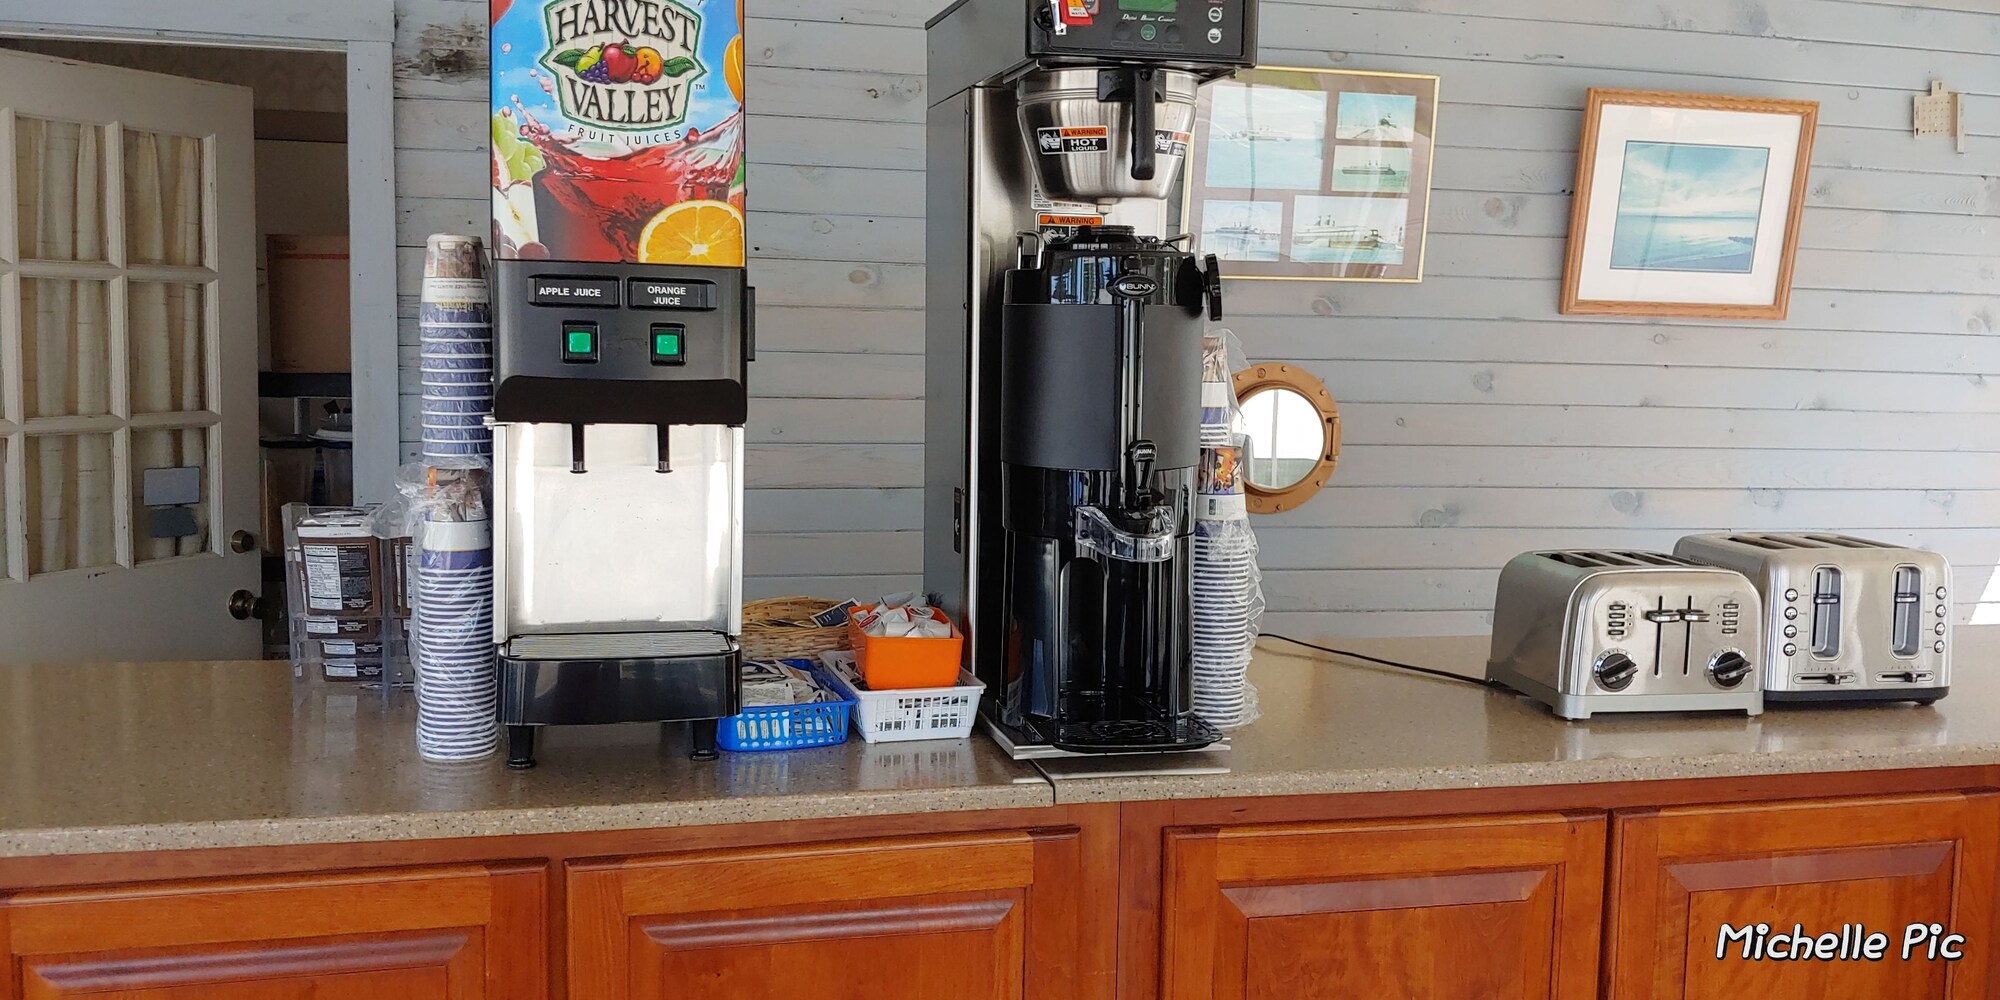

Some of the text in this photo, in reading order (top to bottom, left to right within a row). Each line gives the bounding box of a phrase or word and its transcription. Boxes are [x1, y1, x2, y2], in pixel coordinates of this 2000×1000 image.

[555, 0, 696, 52] HARVEST
[565, 75, 681, 124] VALLEY
[568, 124, 681, 146] FRUIT JUICES
[1070, 138, 1099, 146] HOT
[1059, 216, 1095, 224] WARNING
[539, 287, 601, 297] APPLE JUICE
[647, 286, 687, 295] ORANGE
[653, 297, 681, 305] JUICE
